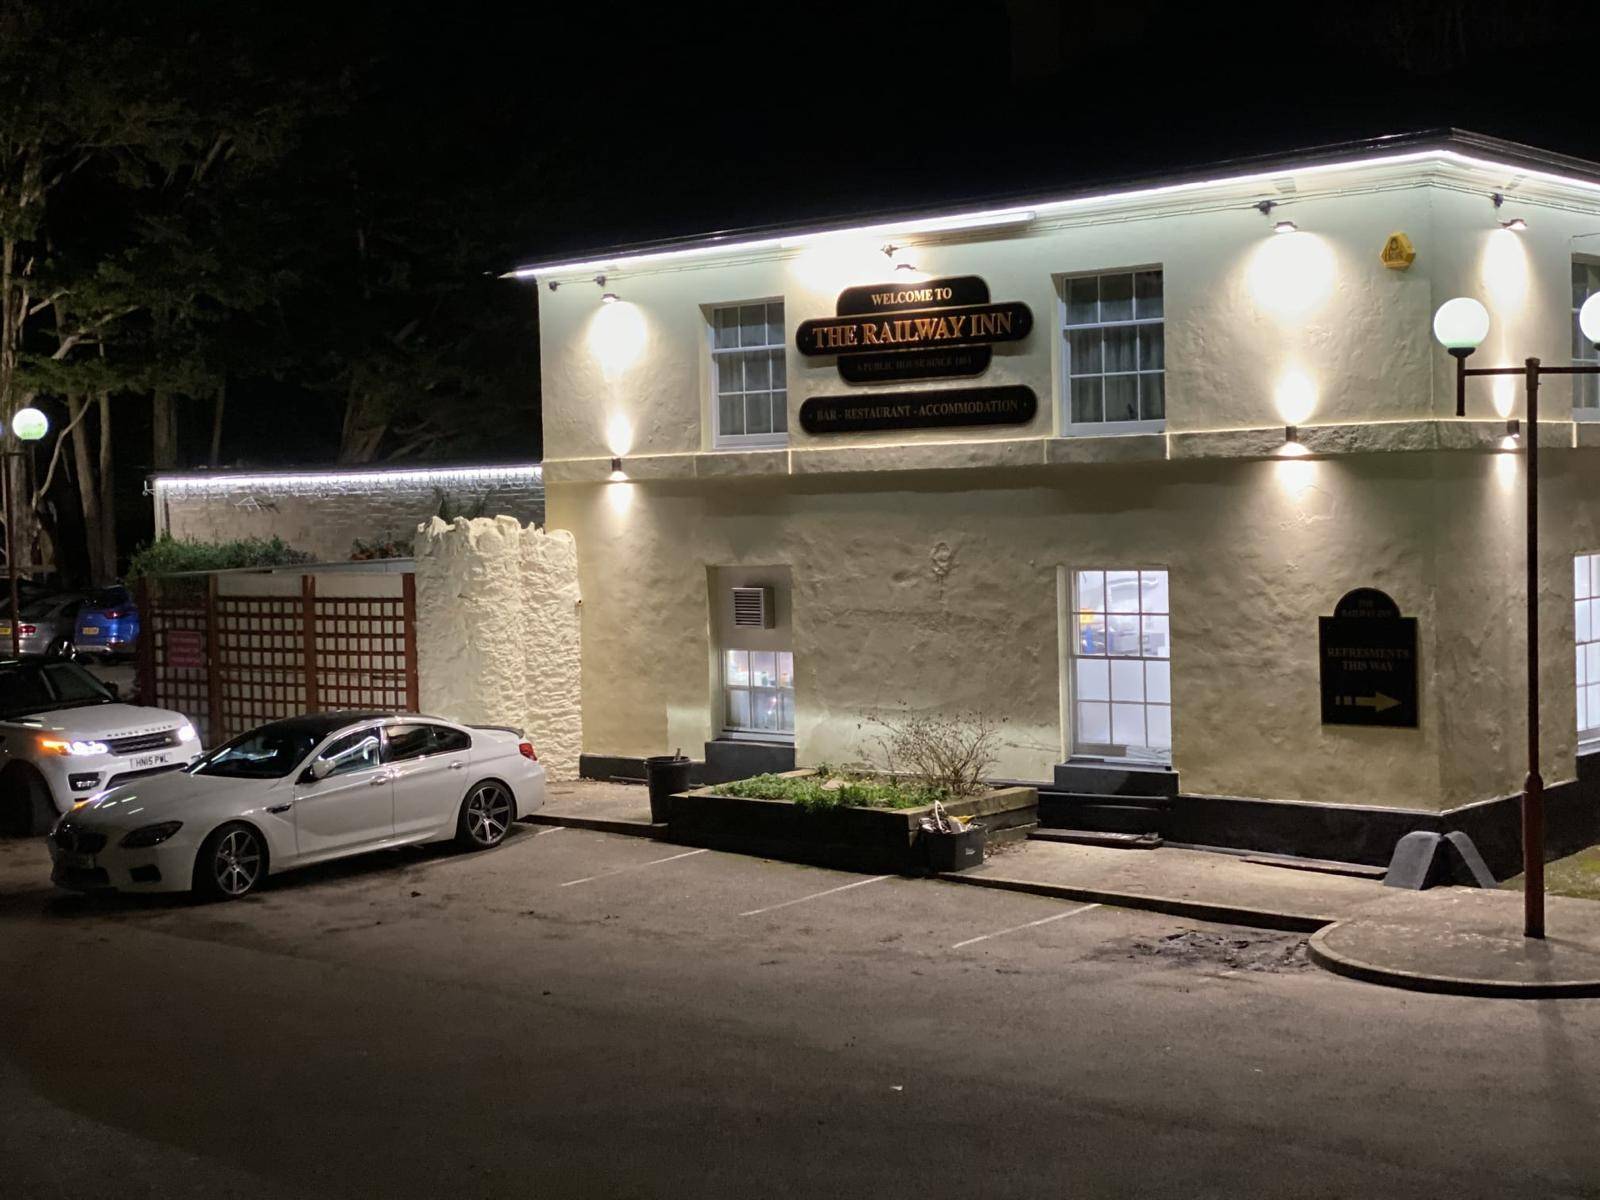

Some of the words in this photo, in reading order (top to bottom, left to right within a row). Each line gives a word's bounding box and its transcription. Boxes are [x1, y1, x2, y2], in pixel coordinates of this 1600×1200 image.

[871, 288, 933, 306] WELCOME
[935, 286, 953, 300] TO
[812, 325, 858, 349] THE
[861, 316, 966, 345] RAILWAY
[970, 312, 1013, 336] INN
[816, 409, 838, 421] BAR
[844, 405, 913, 420] RESTAURANT
[918, 399, 1019, 417] ACCOMMODATION
[1342, 660, 1367, 671] THIS
[1369, 660, 1393, 672] WAY
